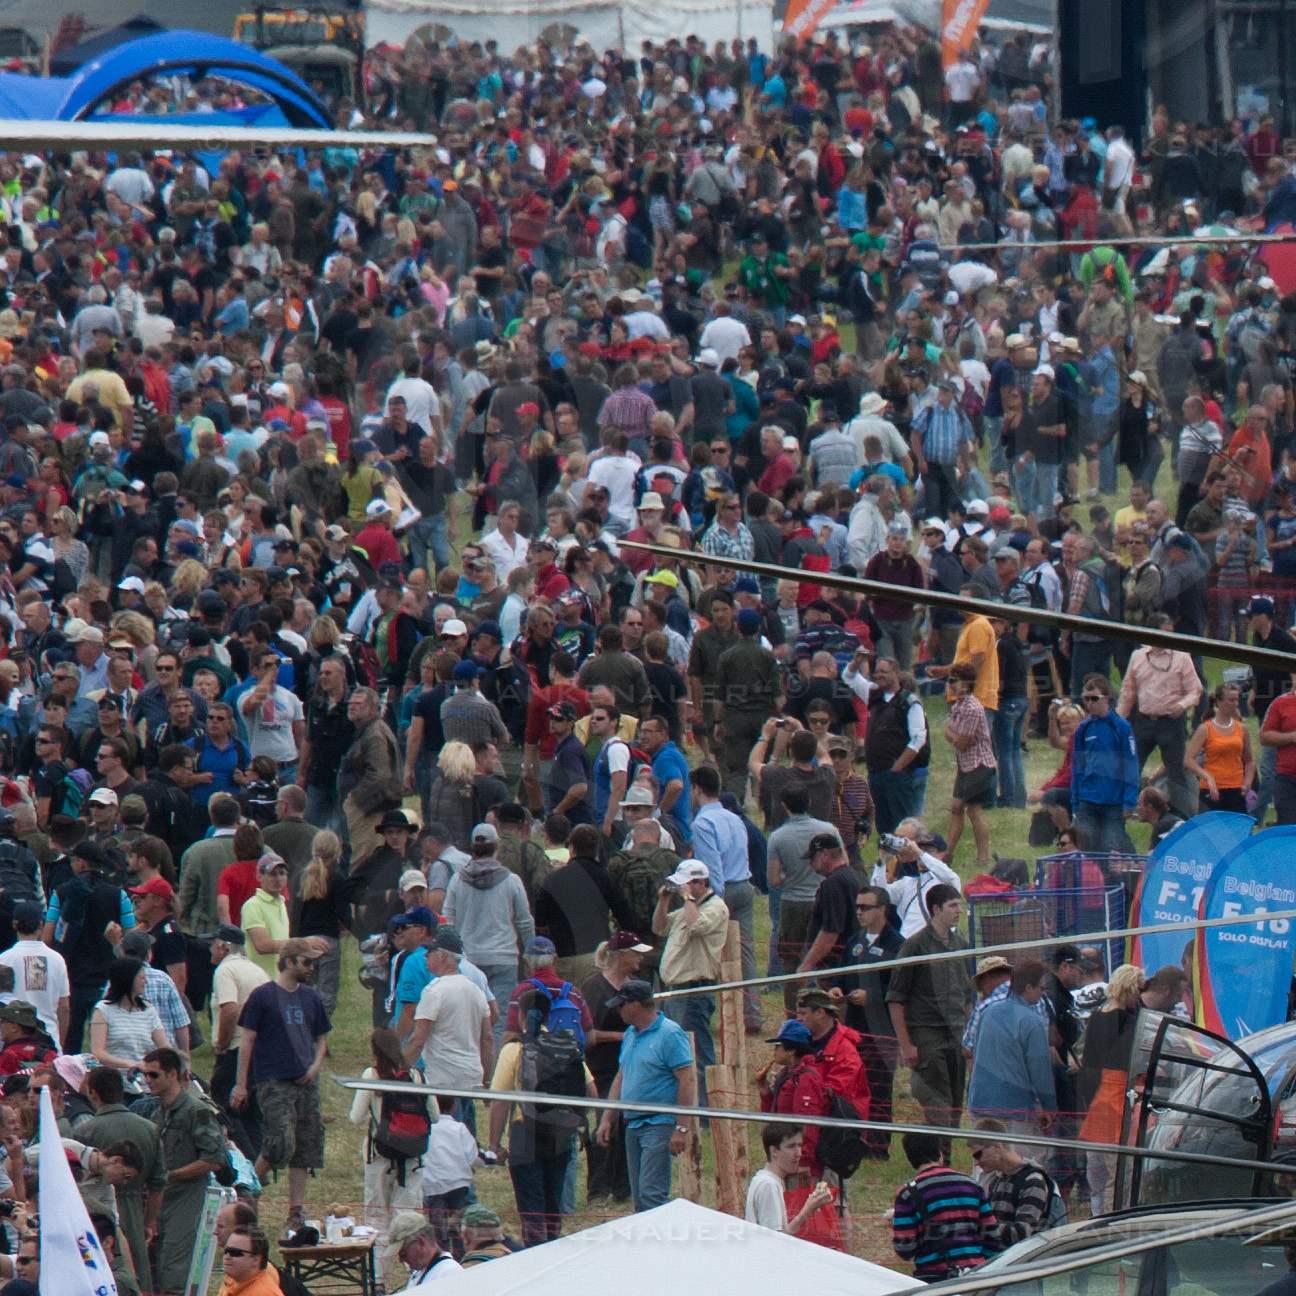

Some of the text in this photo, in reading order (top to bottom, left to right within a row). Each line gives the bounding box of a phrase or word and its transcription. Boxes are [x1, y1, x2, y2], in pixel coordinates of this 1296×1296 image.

[1223, 876, 1296, 903] Belgian
[1218, 931, 1288, 949] SOLO DISPLAY
